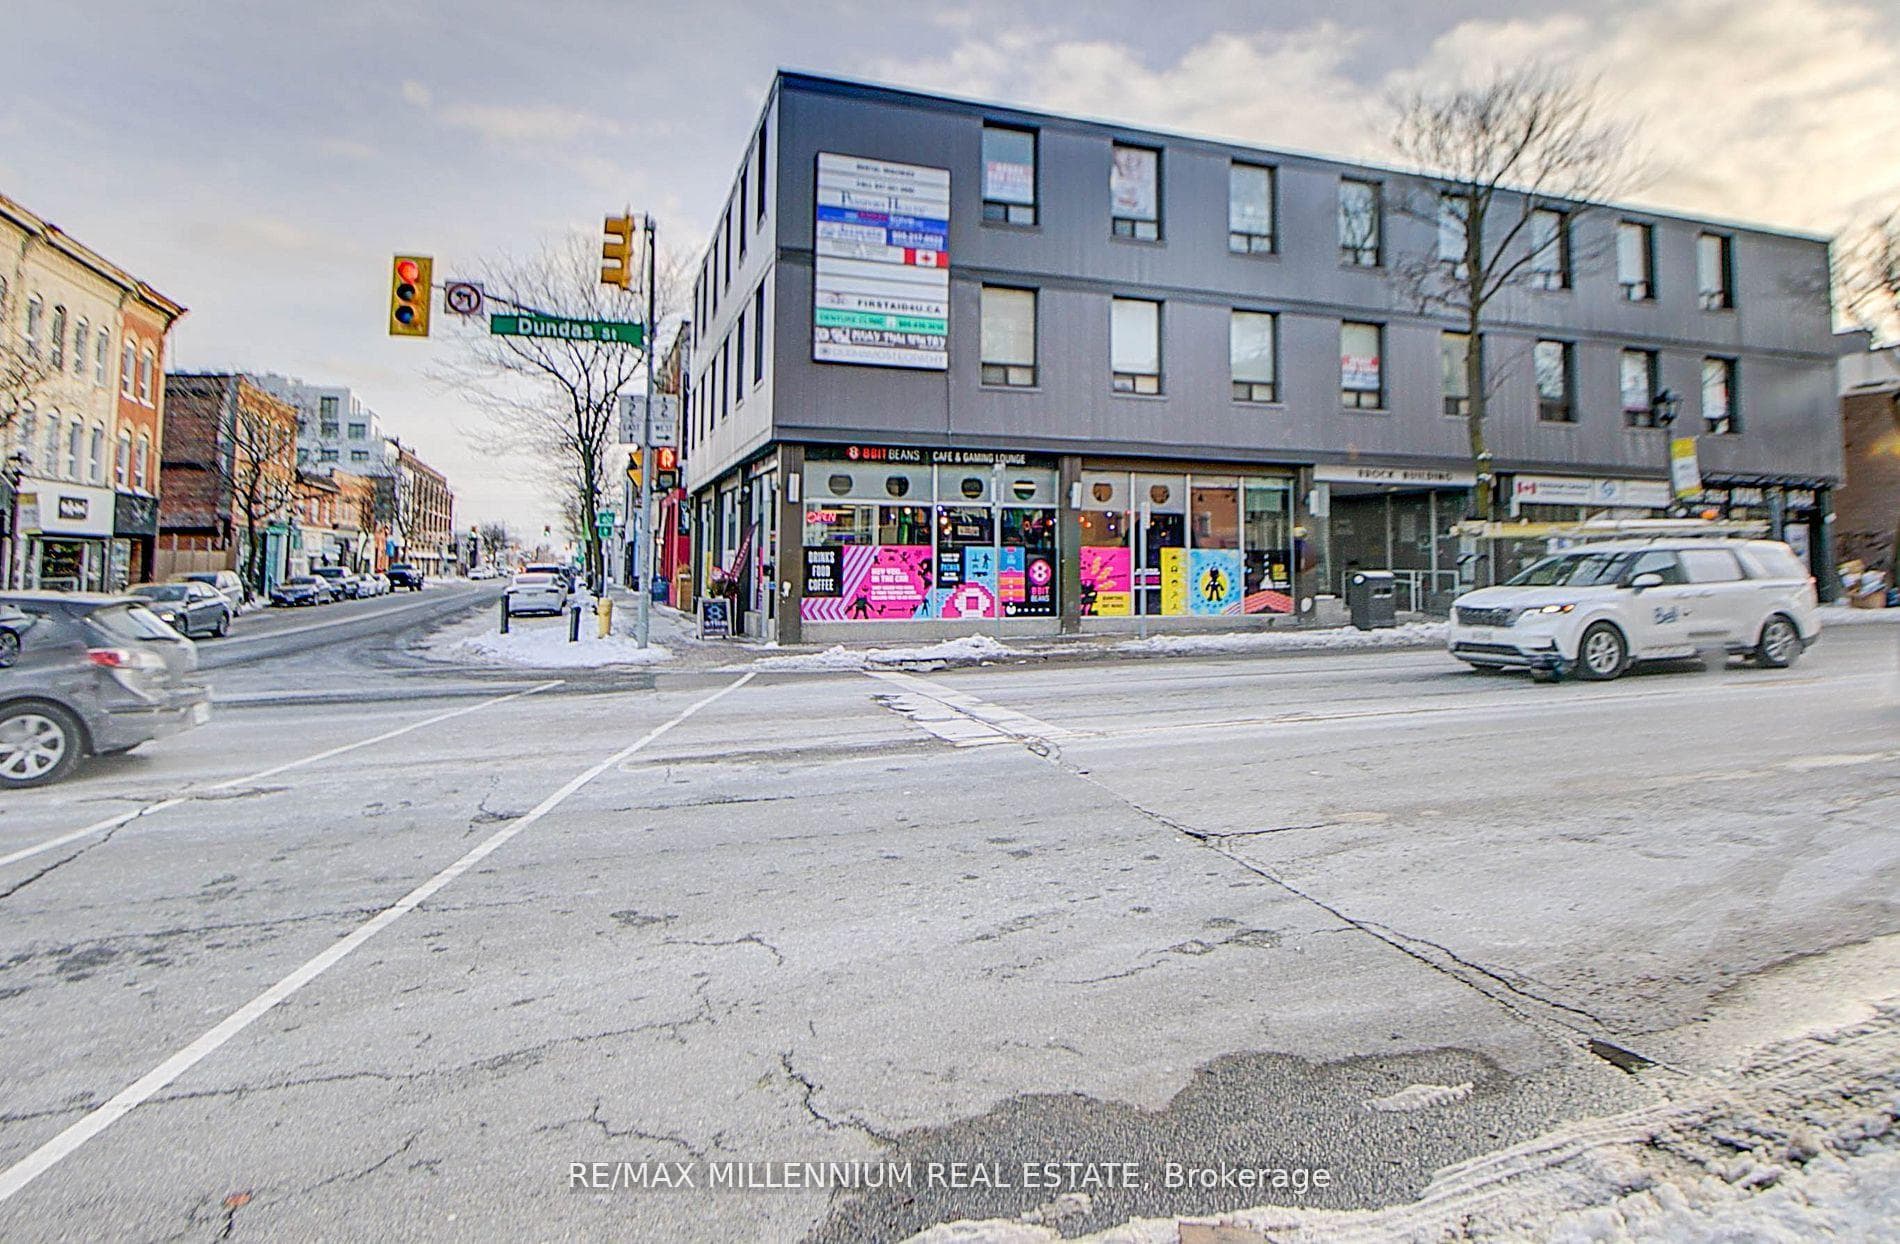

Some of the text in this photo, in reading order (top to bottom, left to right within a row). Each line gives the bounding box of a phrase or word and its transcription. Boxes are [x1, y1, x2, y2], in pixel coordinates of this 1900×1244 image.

[517, 317, 593, 340] Dundas
[628, 403, 636, 417] 2
[661, 404, 668, 418] 2
[888, 449, 920, 462] BEANS
[932, 451, 953, 463] CAFE
[963, 452, 994, 464] GAMING
[995, 453, 1026, 465] LOUNGE
[808, 551, 835, 564] DRINKS
[812, 565, 831, 577] FOOD
[808, 579, 834, 591] COFFEE
